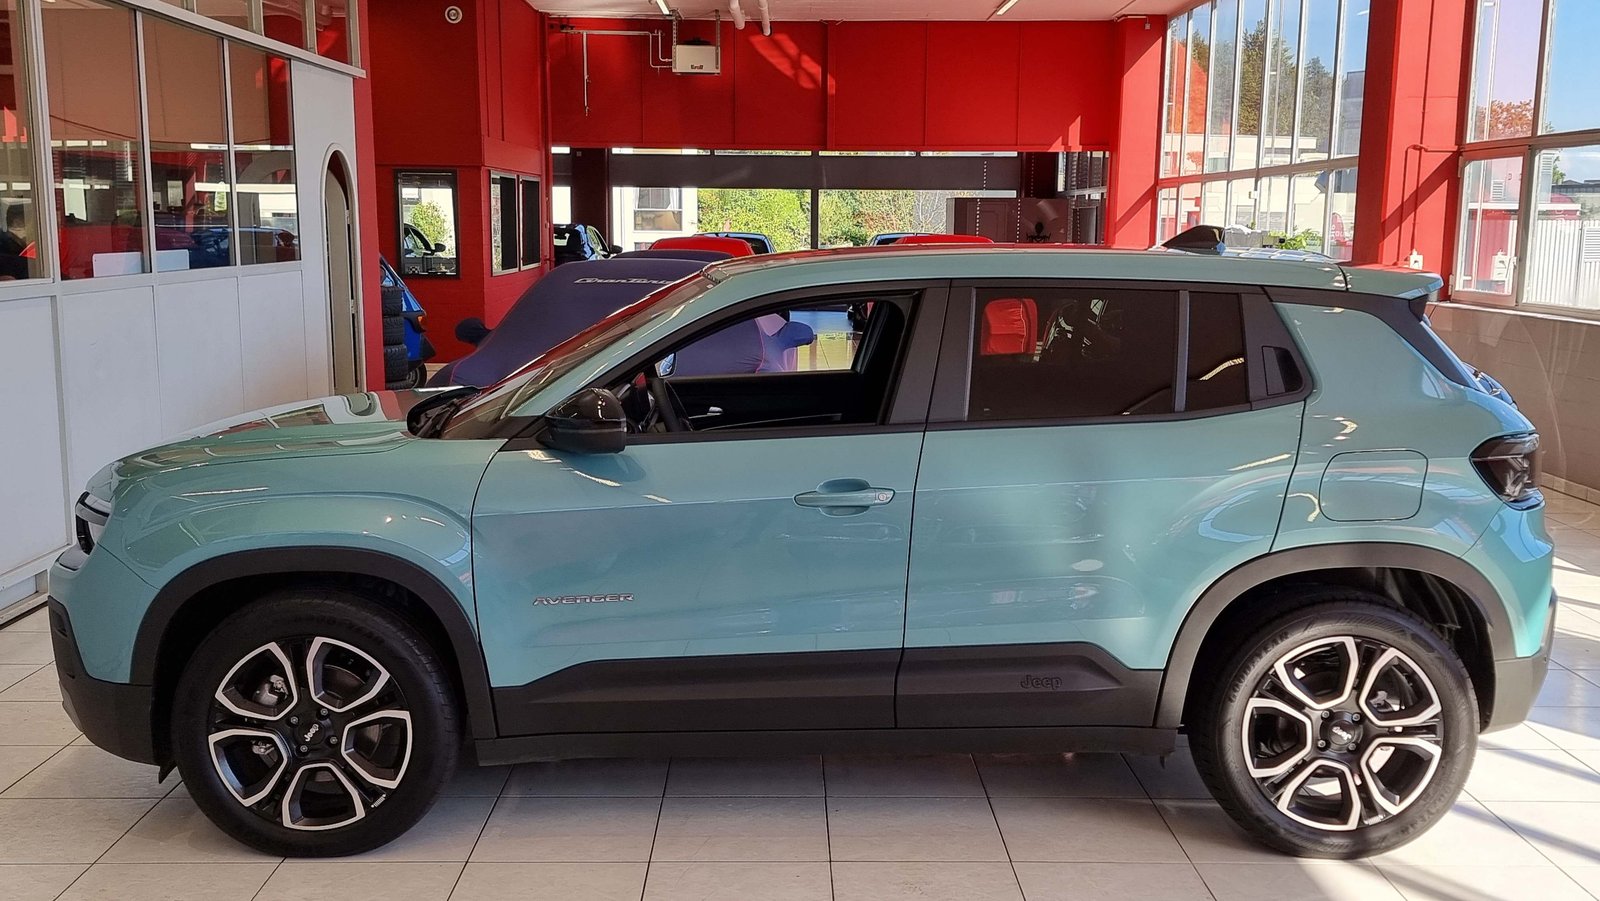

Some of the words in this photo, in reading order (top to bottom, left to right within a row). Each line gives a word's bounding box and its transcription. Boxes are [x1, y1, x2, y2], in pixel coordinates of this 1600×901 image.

[533, 593, 634, 606] AVENGER
[1020, 674, 1063, 690] Jeep
[303, 723, 319, 742] Jeep
